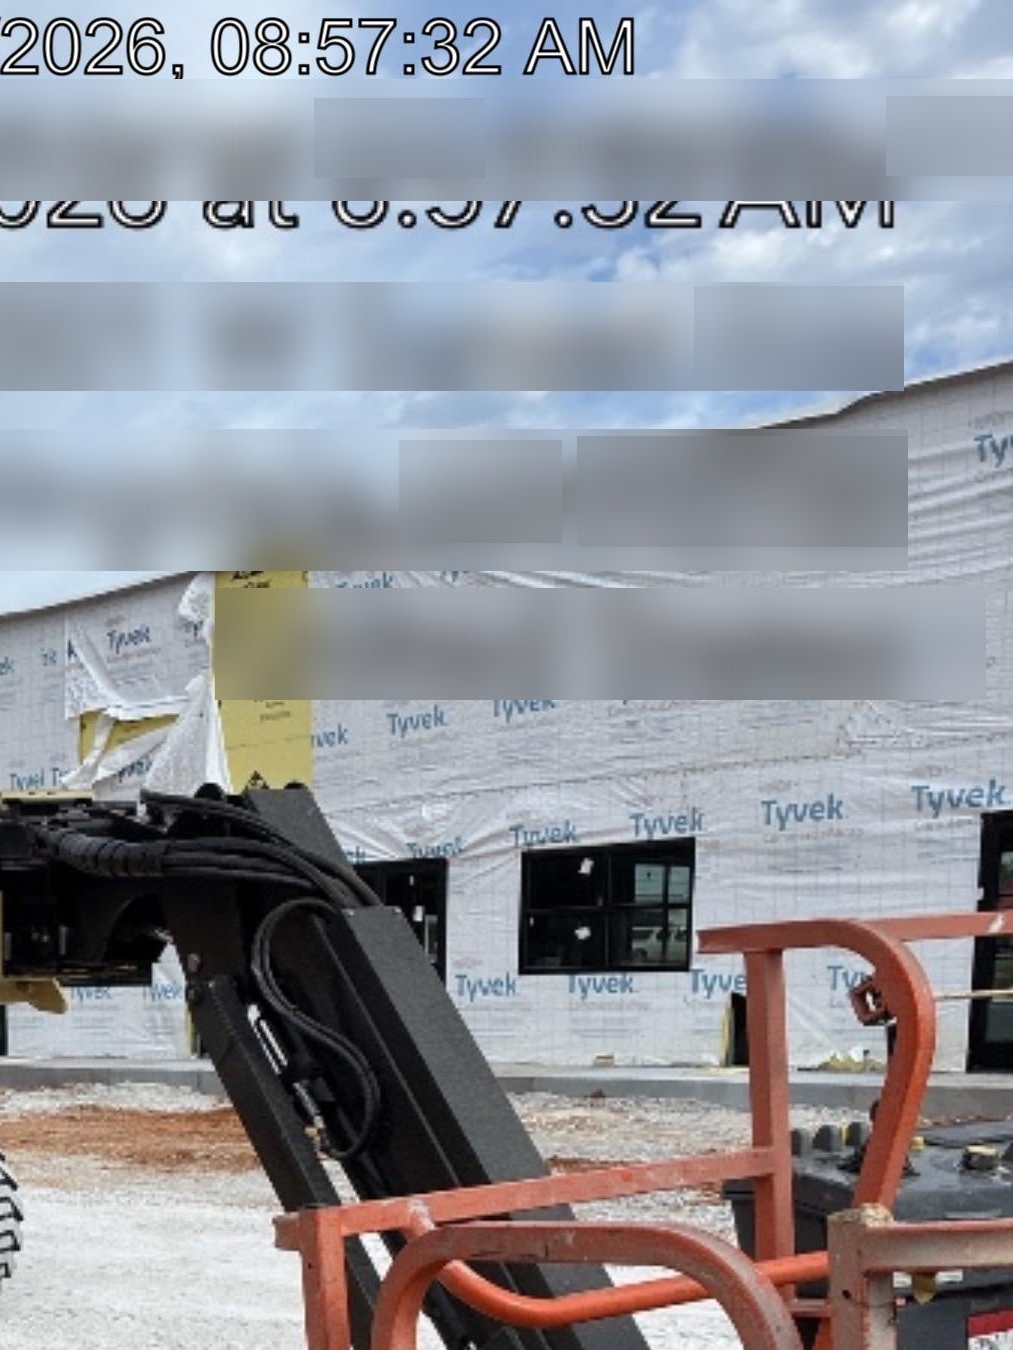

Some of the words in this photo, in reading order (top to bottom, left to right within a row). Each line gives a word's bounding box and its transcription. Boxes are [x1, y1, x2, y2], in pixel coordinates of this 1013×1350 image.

[387, 704, 447, 738] Tyvek
[761, 793, 843, 831] Tyvek
[912, 779, 1006, 817] Tyvek
[630, 807, 705, 840] Tyvek
[455, 973, 517, 1001] Tyvek
[568, 973, 634, 999] Tyvek
[691, 969, 746, 999] Tyve
